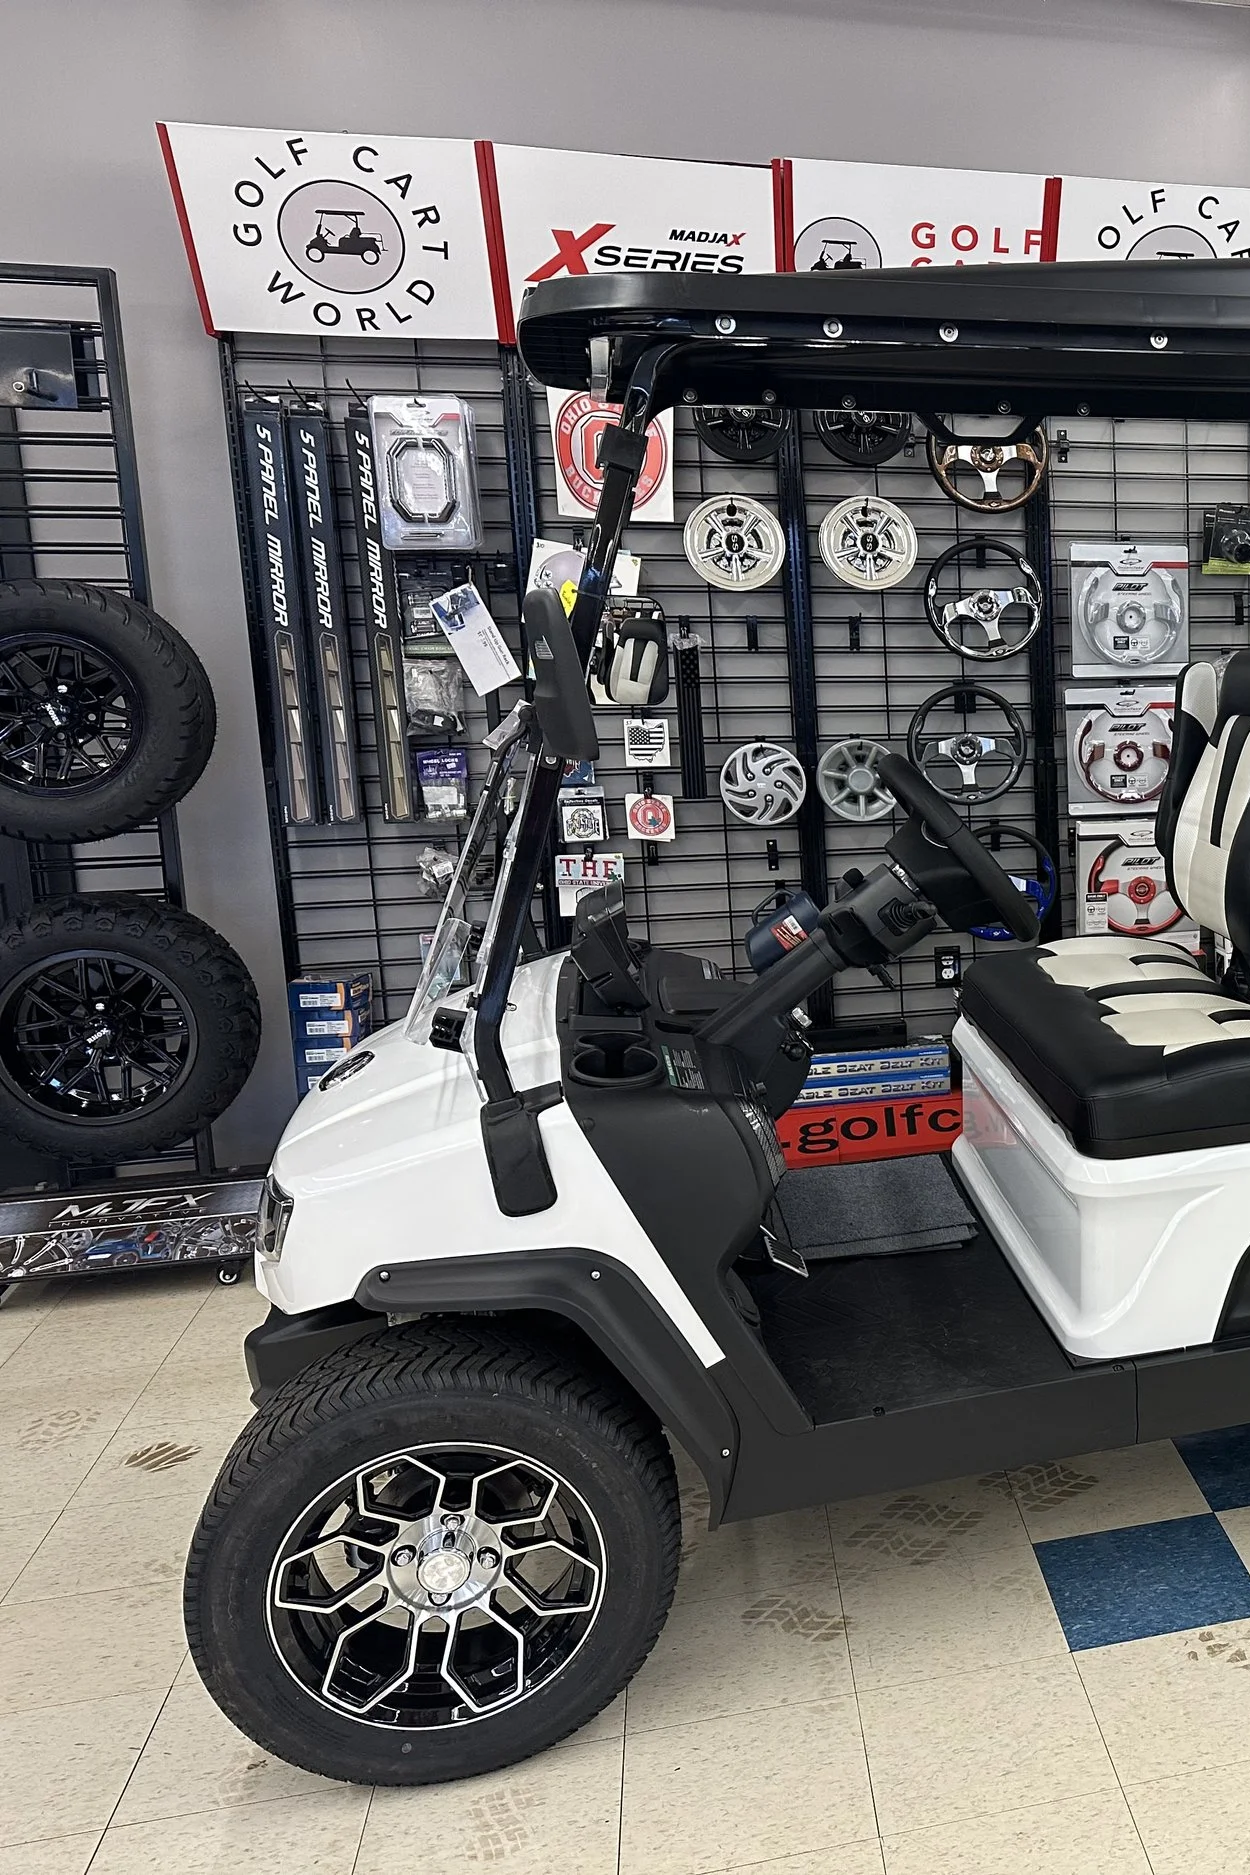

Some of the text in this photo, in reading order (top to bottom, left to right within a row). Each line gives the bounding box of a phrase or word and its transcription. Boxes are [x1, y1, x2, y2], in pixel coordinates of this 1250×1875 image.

[233, 137, 449, 260] GOLF CART
[1098, 188, 1166, 250] OLF
[669, 229, 746, 247] MADJAX
[267, 270, 436, 331] WORLD
[256, 423, 290, 627] 5 PANEL MIRROR
[300, 430, 333, 628] 5 PANEL MIRROR
[355, 430, 388, 629] 5 PANEL MIRROR
[1113, 583, 1149, 591] PILOT
[1109, 723, 1147, 732] PILOT
[1121, 856, 1161, 866] PILOT
[48, 1207, 208, 1228] INNOVATIVE
